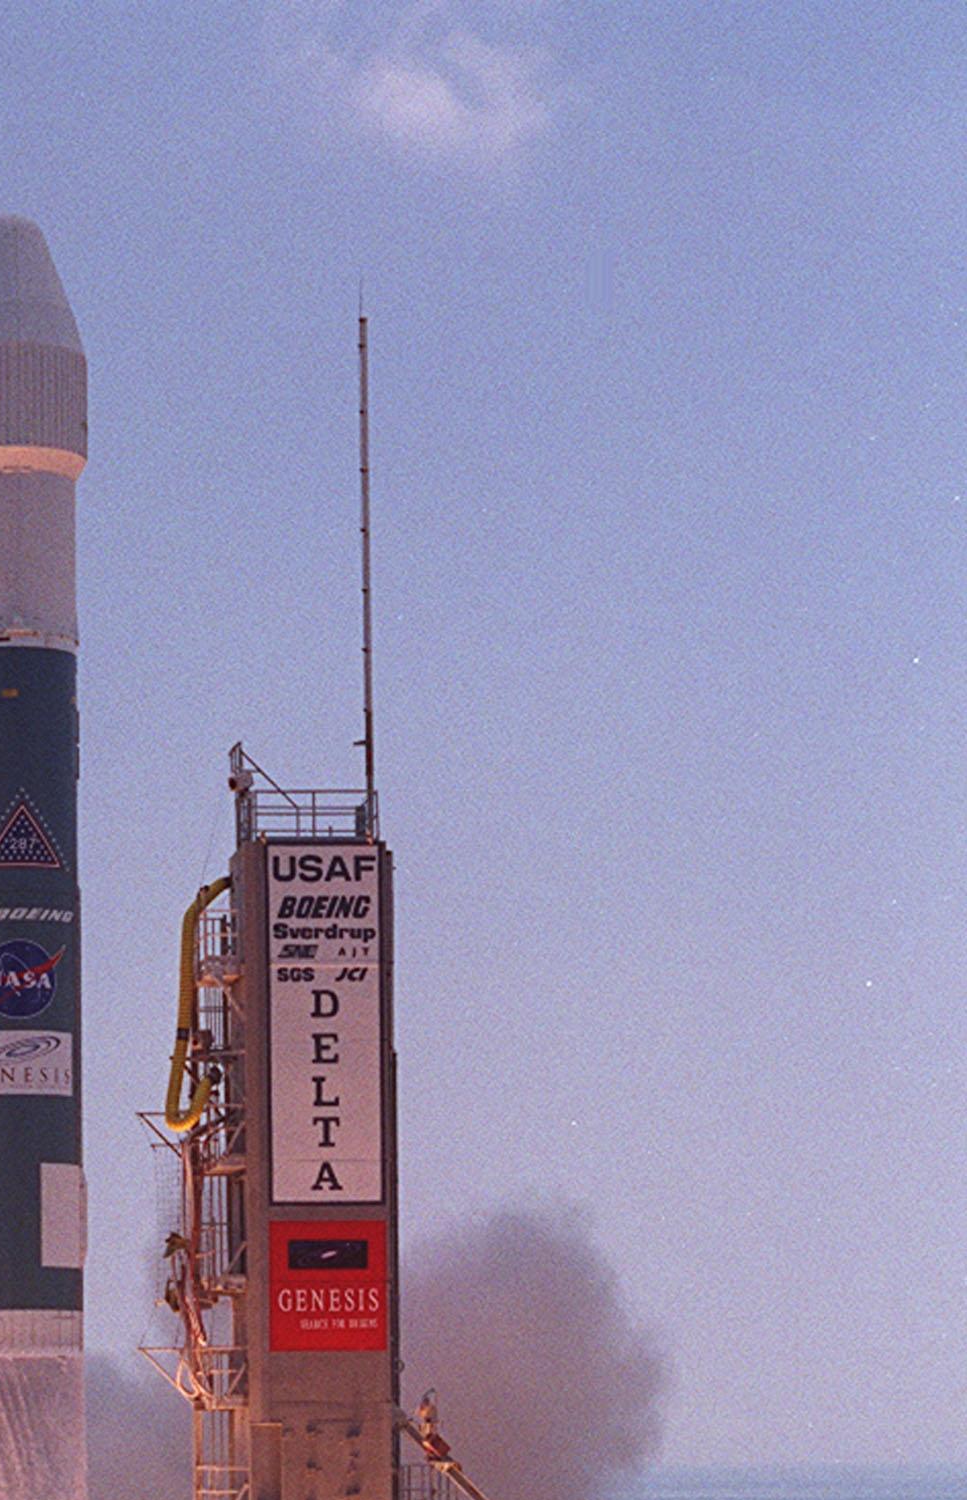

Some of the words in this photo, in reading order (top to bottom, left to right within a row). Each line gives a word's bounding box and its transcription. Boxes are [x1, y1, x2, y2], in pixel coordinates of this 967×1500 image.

[272, 855, 376, 882] USAF
[277, 895, 371, 919] BOEING
[273, 922, 376, 942] Sverdrup
[277, 967, 315, 982] SGS
[335, 967, 368, 982] JCI
[311, 989, 343, 1191] DELTA
[278, 1287, 380, 1313] GENESIS
